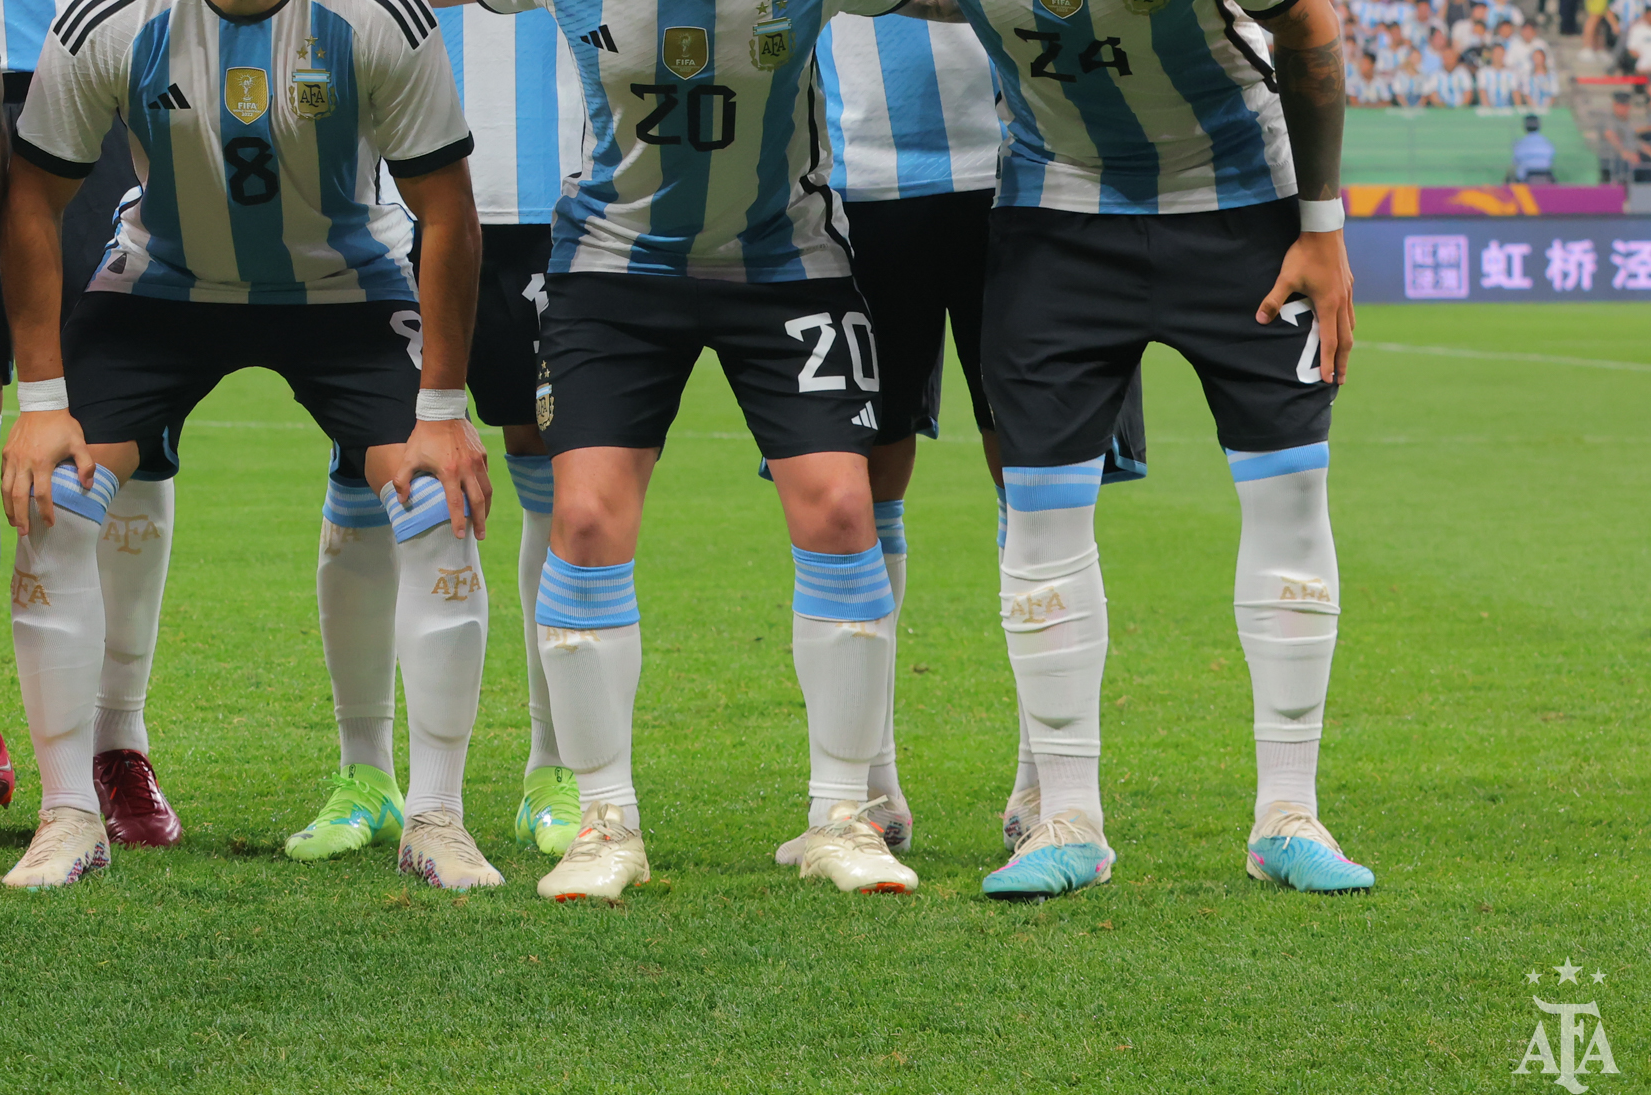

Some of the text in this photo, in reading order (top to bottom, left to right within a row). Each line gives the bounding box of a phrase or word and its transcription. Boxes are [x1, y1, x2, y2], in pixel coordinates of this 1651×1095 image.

[761, 33, 787, 56] AFA
[1014, 27, 1133, 83] 24
[300, 83, 326, 107] AFA
[630, 83, 737, 152] 20
[224, 136, 280, 206] 8
[784, 311, 880, 393] 20
[103, 512, 161, 555] AFA
[431, 566, 482, 601] AFA
